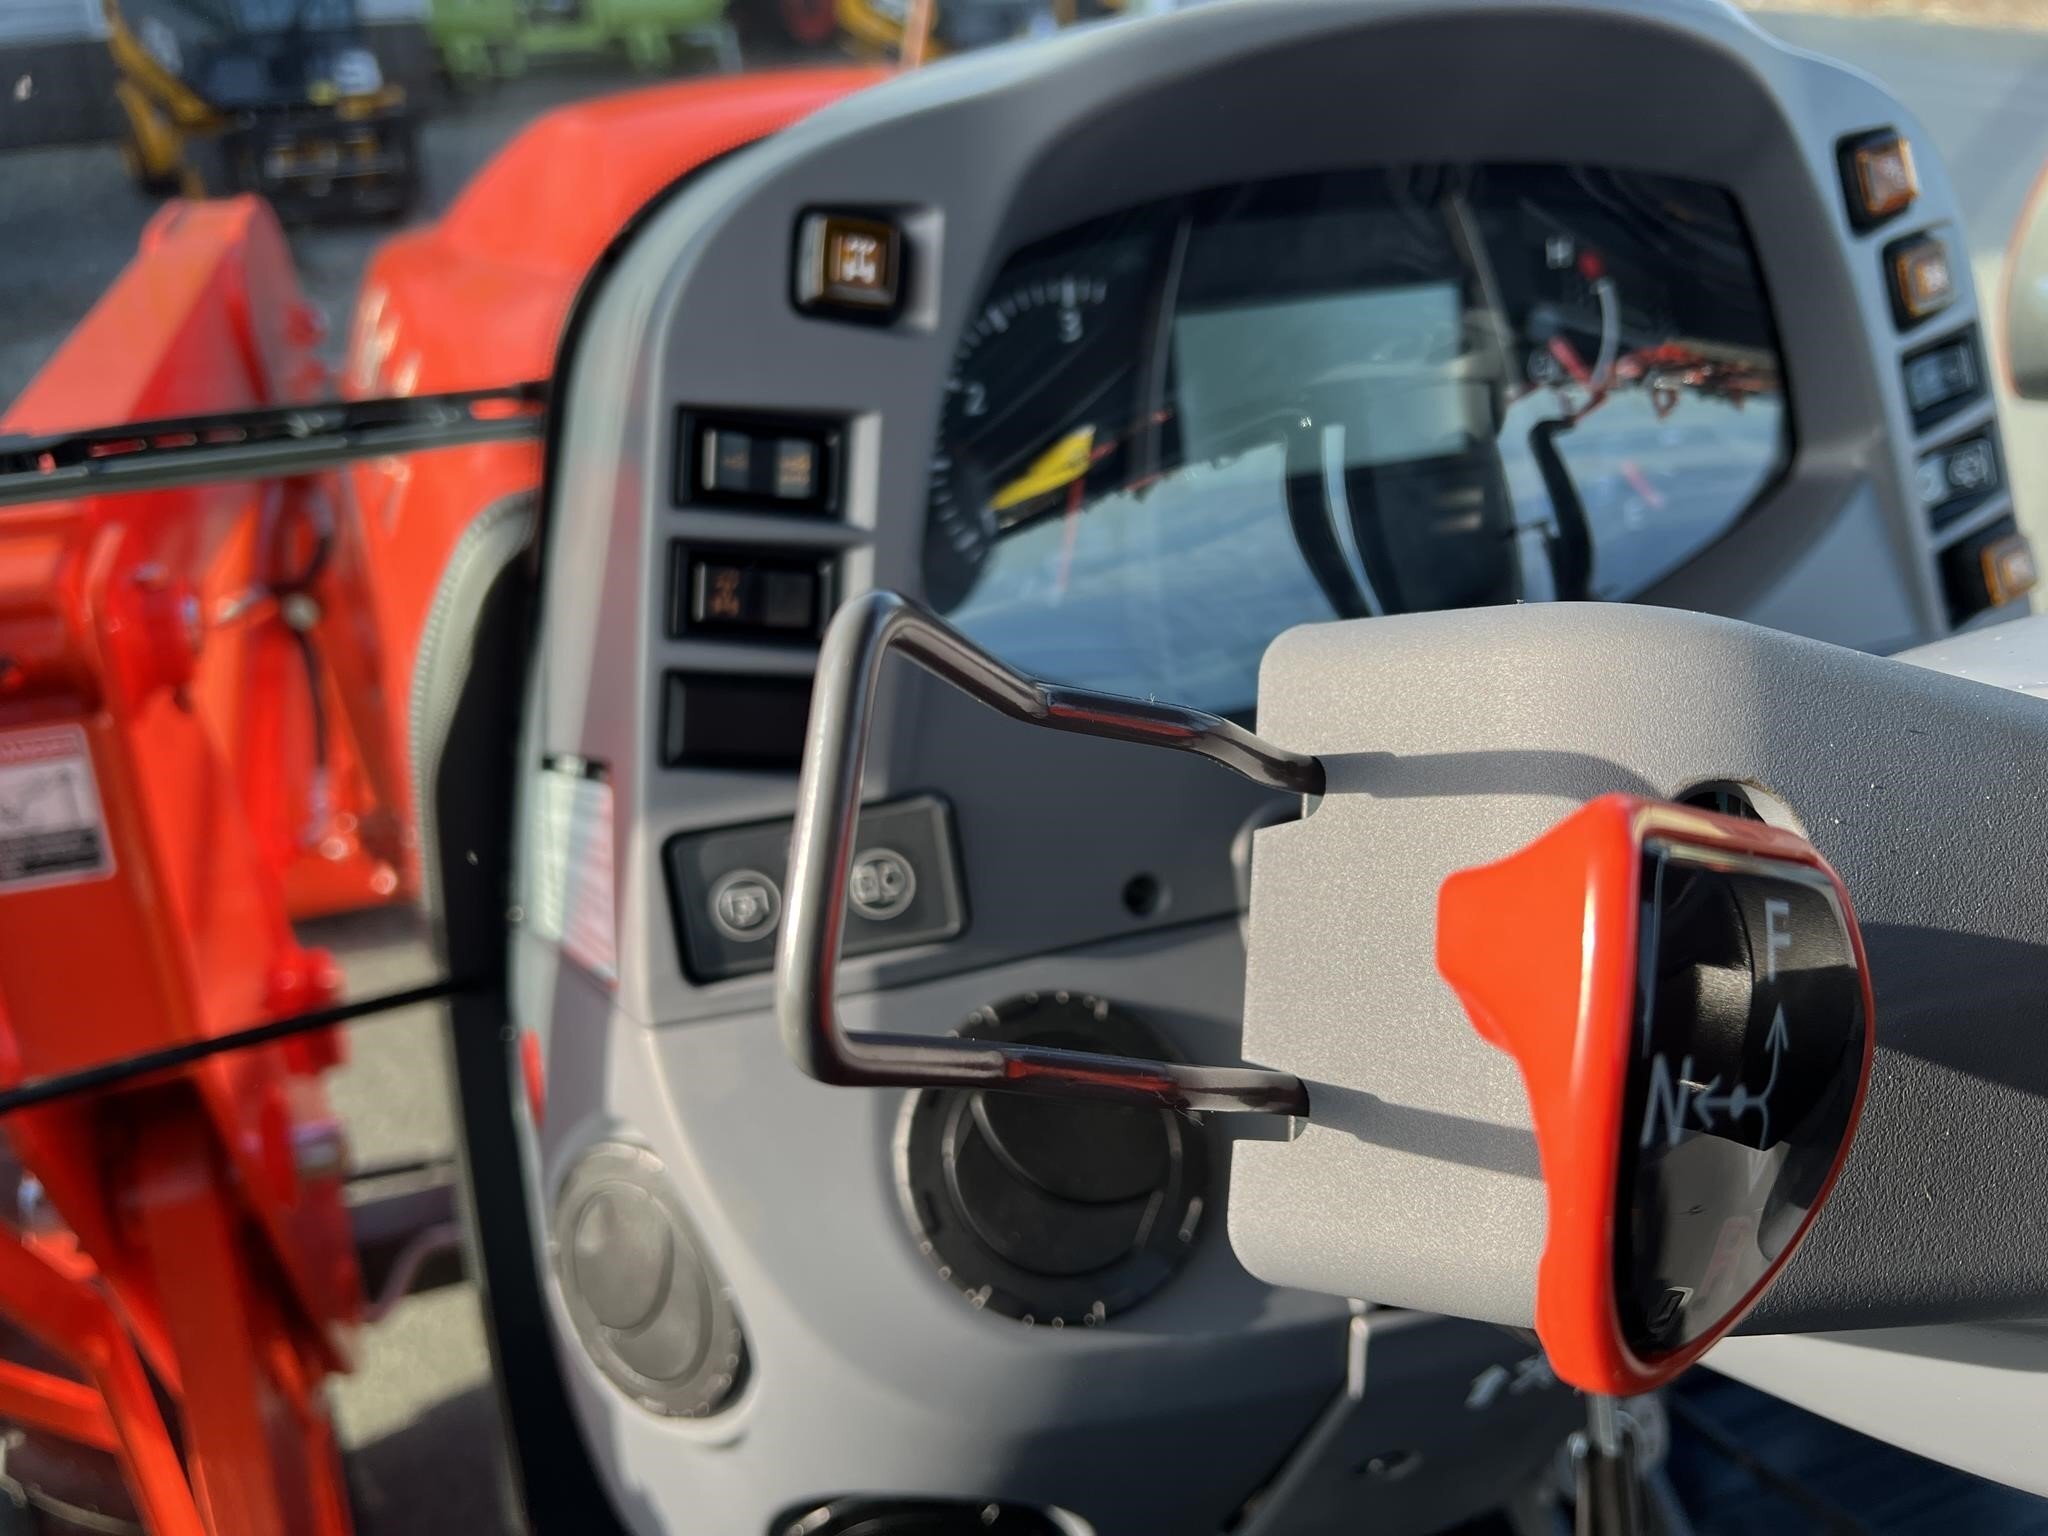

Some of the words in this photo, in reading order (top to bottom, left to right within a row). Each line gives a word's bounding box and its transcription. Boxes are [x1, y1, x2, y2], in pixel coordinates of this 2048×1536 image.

[962, 380, 988, 417] 2
[1763, 899, 1790, 984] F
[1640, 1052, 1695, 1147] N
